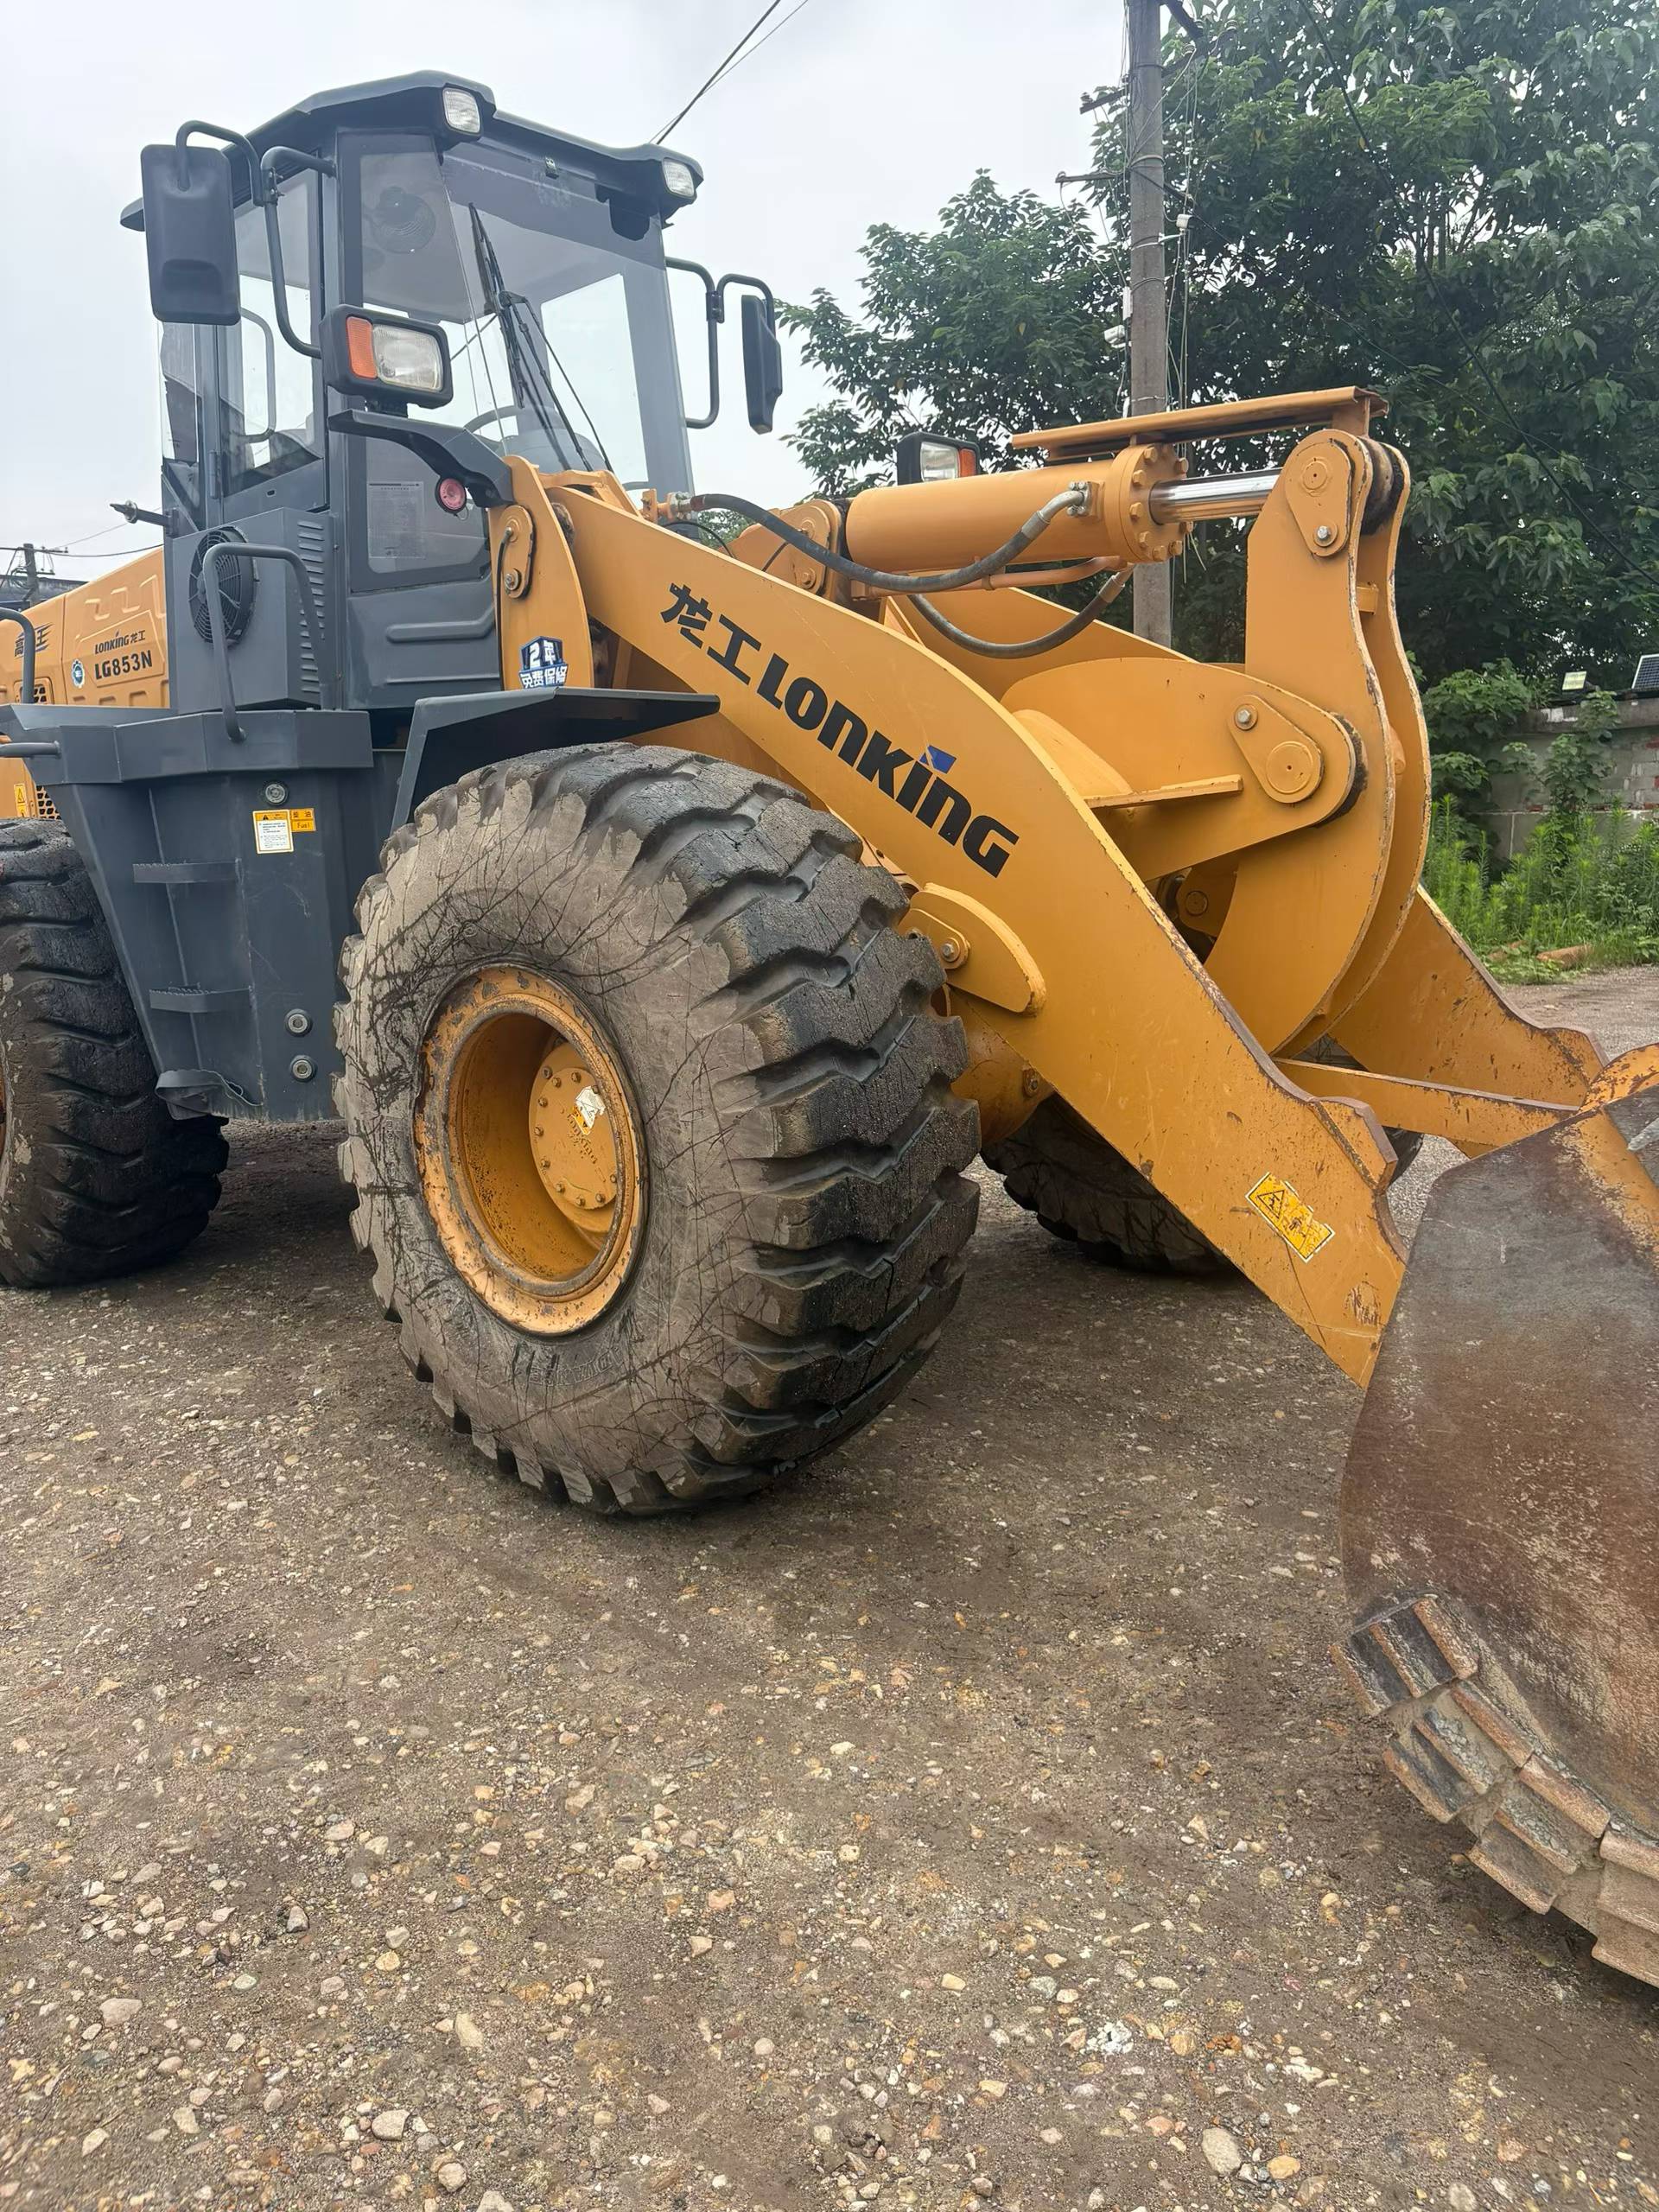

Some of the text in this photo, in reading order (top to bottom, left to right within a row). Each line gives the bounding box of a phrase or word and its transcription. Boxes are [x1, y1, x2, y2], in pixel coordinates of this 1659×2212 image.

[659, 582, 761, 685] 龙工
[94, 650, 153, 680] LG853N
[529, 639, 556, 670] 2年
